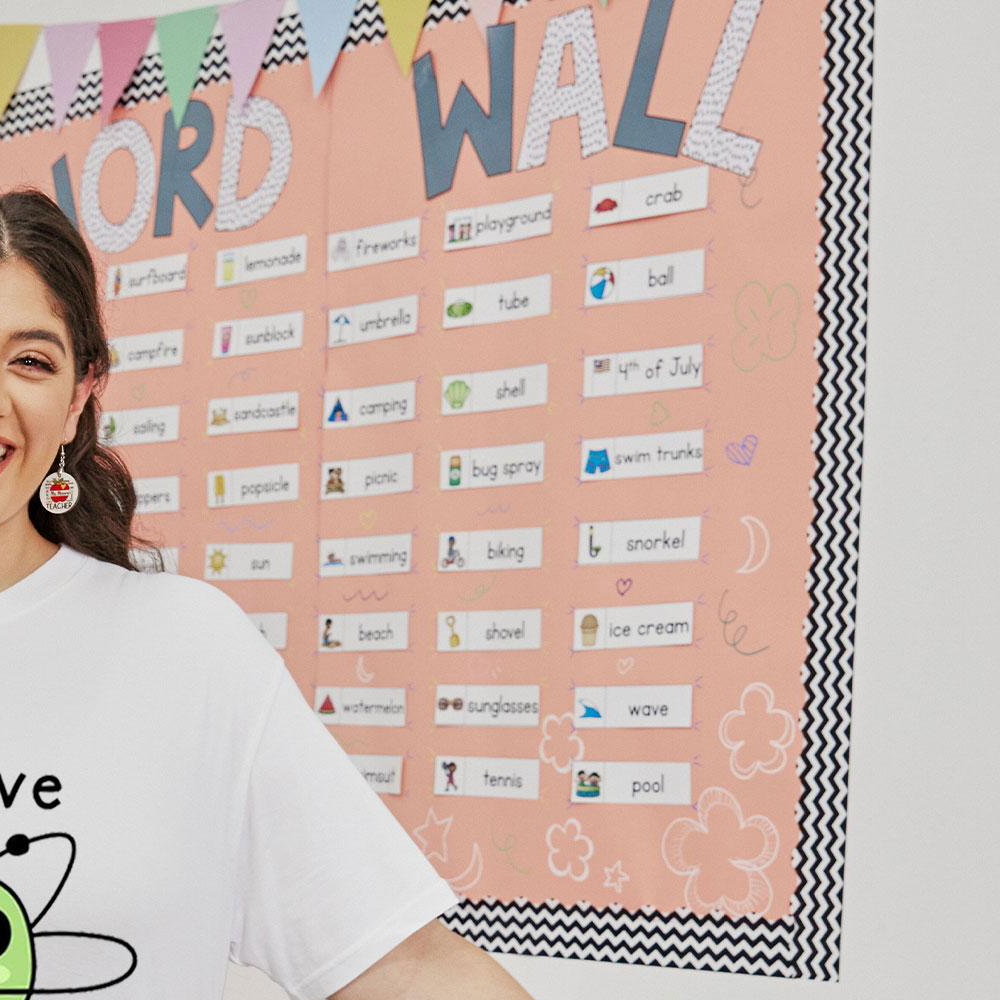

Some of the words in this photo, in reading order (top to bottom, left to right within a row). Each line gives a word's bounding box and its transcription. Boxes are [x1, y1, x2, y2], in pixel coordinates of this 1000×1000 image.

[413, 0, 763, 200] WALL
[645, 183, 683, 206] crab
[476, 201, 552, 235] playground
[356, 232, 417, 255] fireworks
[245, 248, 302, 272] lemonade
[128, 260, 187, 288] surfboard
[648, 266, 674, 287] ball
[499, 291, 529, 310] tube
[360, 308, 411, 333] umbrella
[245, 326, 295, 346] sunblock
[127, 343, 179, 363] campfire
[619, 361, 639, 380] 4th
[645, 360, 663, 379] of
[669, 357, 701, 378] July
[496, 378, 526, 400] shell
[234, 405, 296, 421] sandcastle
[359, 398, 408, 420] camping
[133, 419, 166, 437] sailing
[614, 449, 650, 466] swim
[657, 443, 702, 462] trunks
[365, 469, 398, 488] picnic
[472, 460, 497, 480] bug
[503, 459, 541, 479] spray
[241, 476, 290, 498] popsicle
[626, 530, 685, 551] snorkel
[349, 549, 407, 568] swimming
[487, 542, 524, 563] biking
[250, 558, 271, 571] sun
[358, 623, 394, 641] beach
[485, 621, 525, 641] shovel
[609, 622, 631, 638] ice
[638, 620, 689, 637] cream
[342, 700, 404, 714] watermelon
[467, 696, 538, 717] sunglasses
[628, 703, 668, 717] wave
[483, 770, 523, 788] tennis
[632, 774, 664, 797] pool
